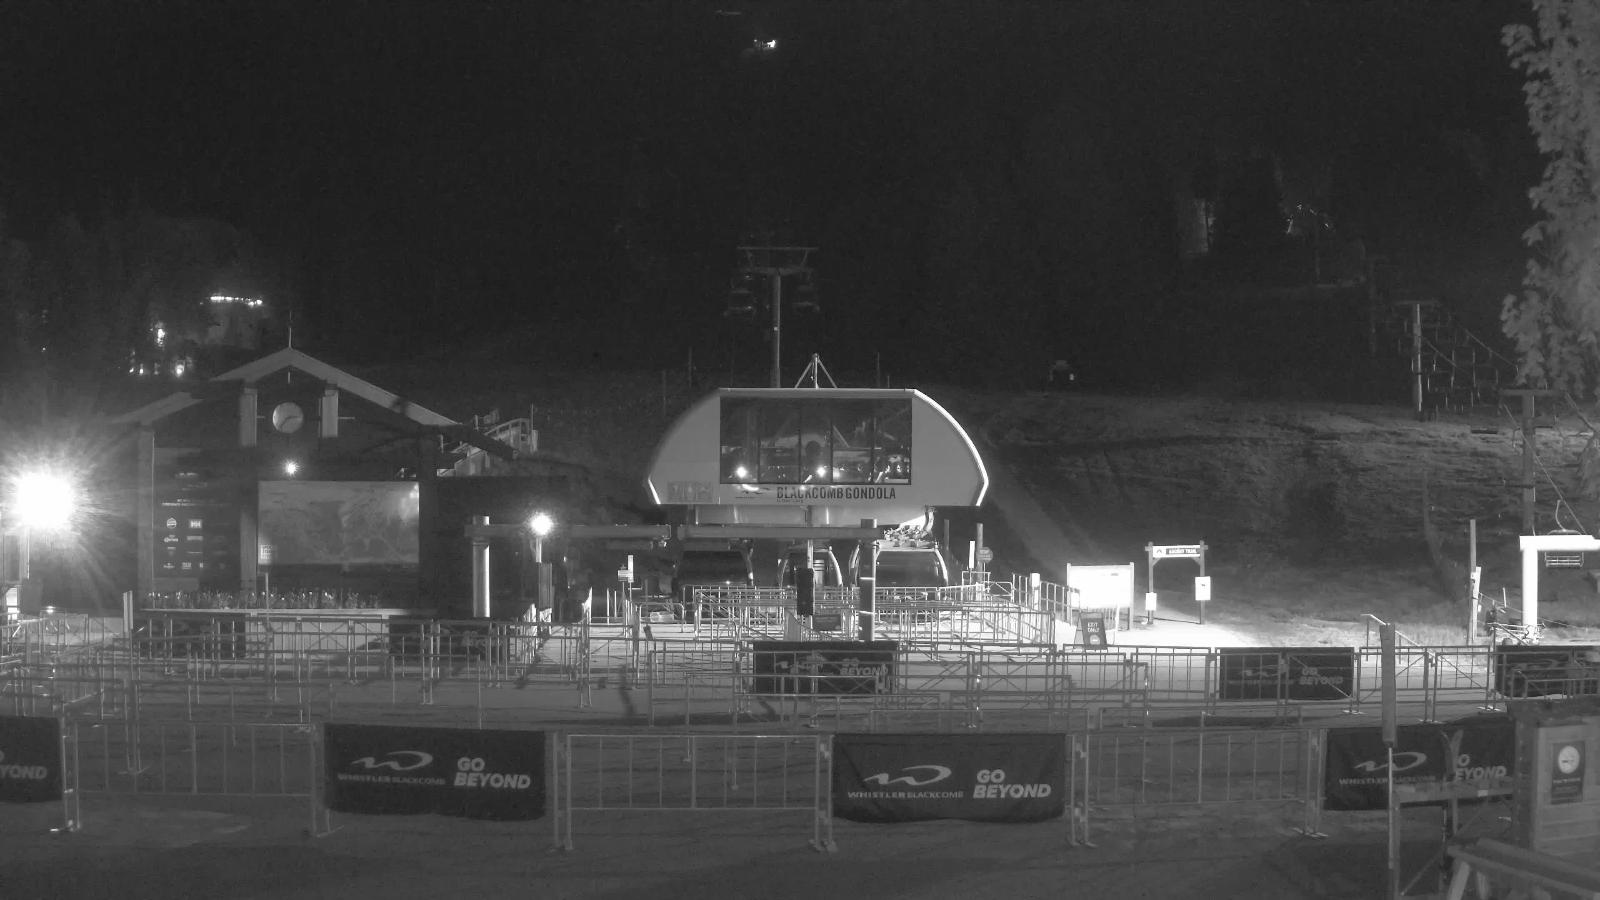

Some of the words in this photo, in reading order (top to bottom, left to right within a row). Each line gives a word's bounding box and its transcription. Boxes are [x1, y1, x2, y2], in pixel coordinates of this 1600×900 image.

[457, 757, 485, 771] GO
[454, 772, 531, 789] BEYOND
[976, 769, 1005, 783] GO
[1454, 766, 1507, 781] EYOND
[972, 784, 1051, 798] BEYOND
